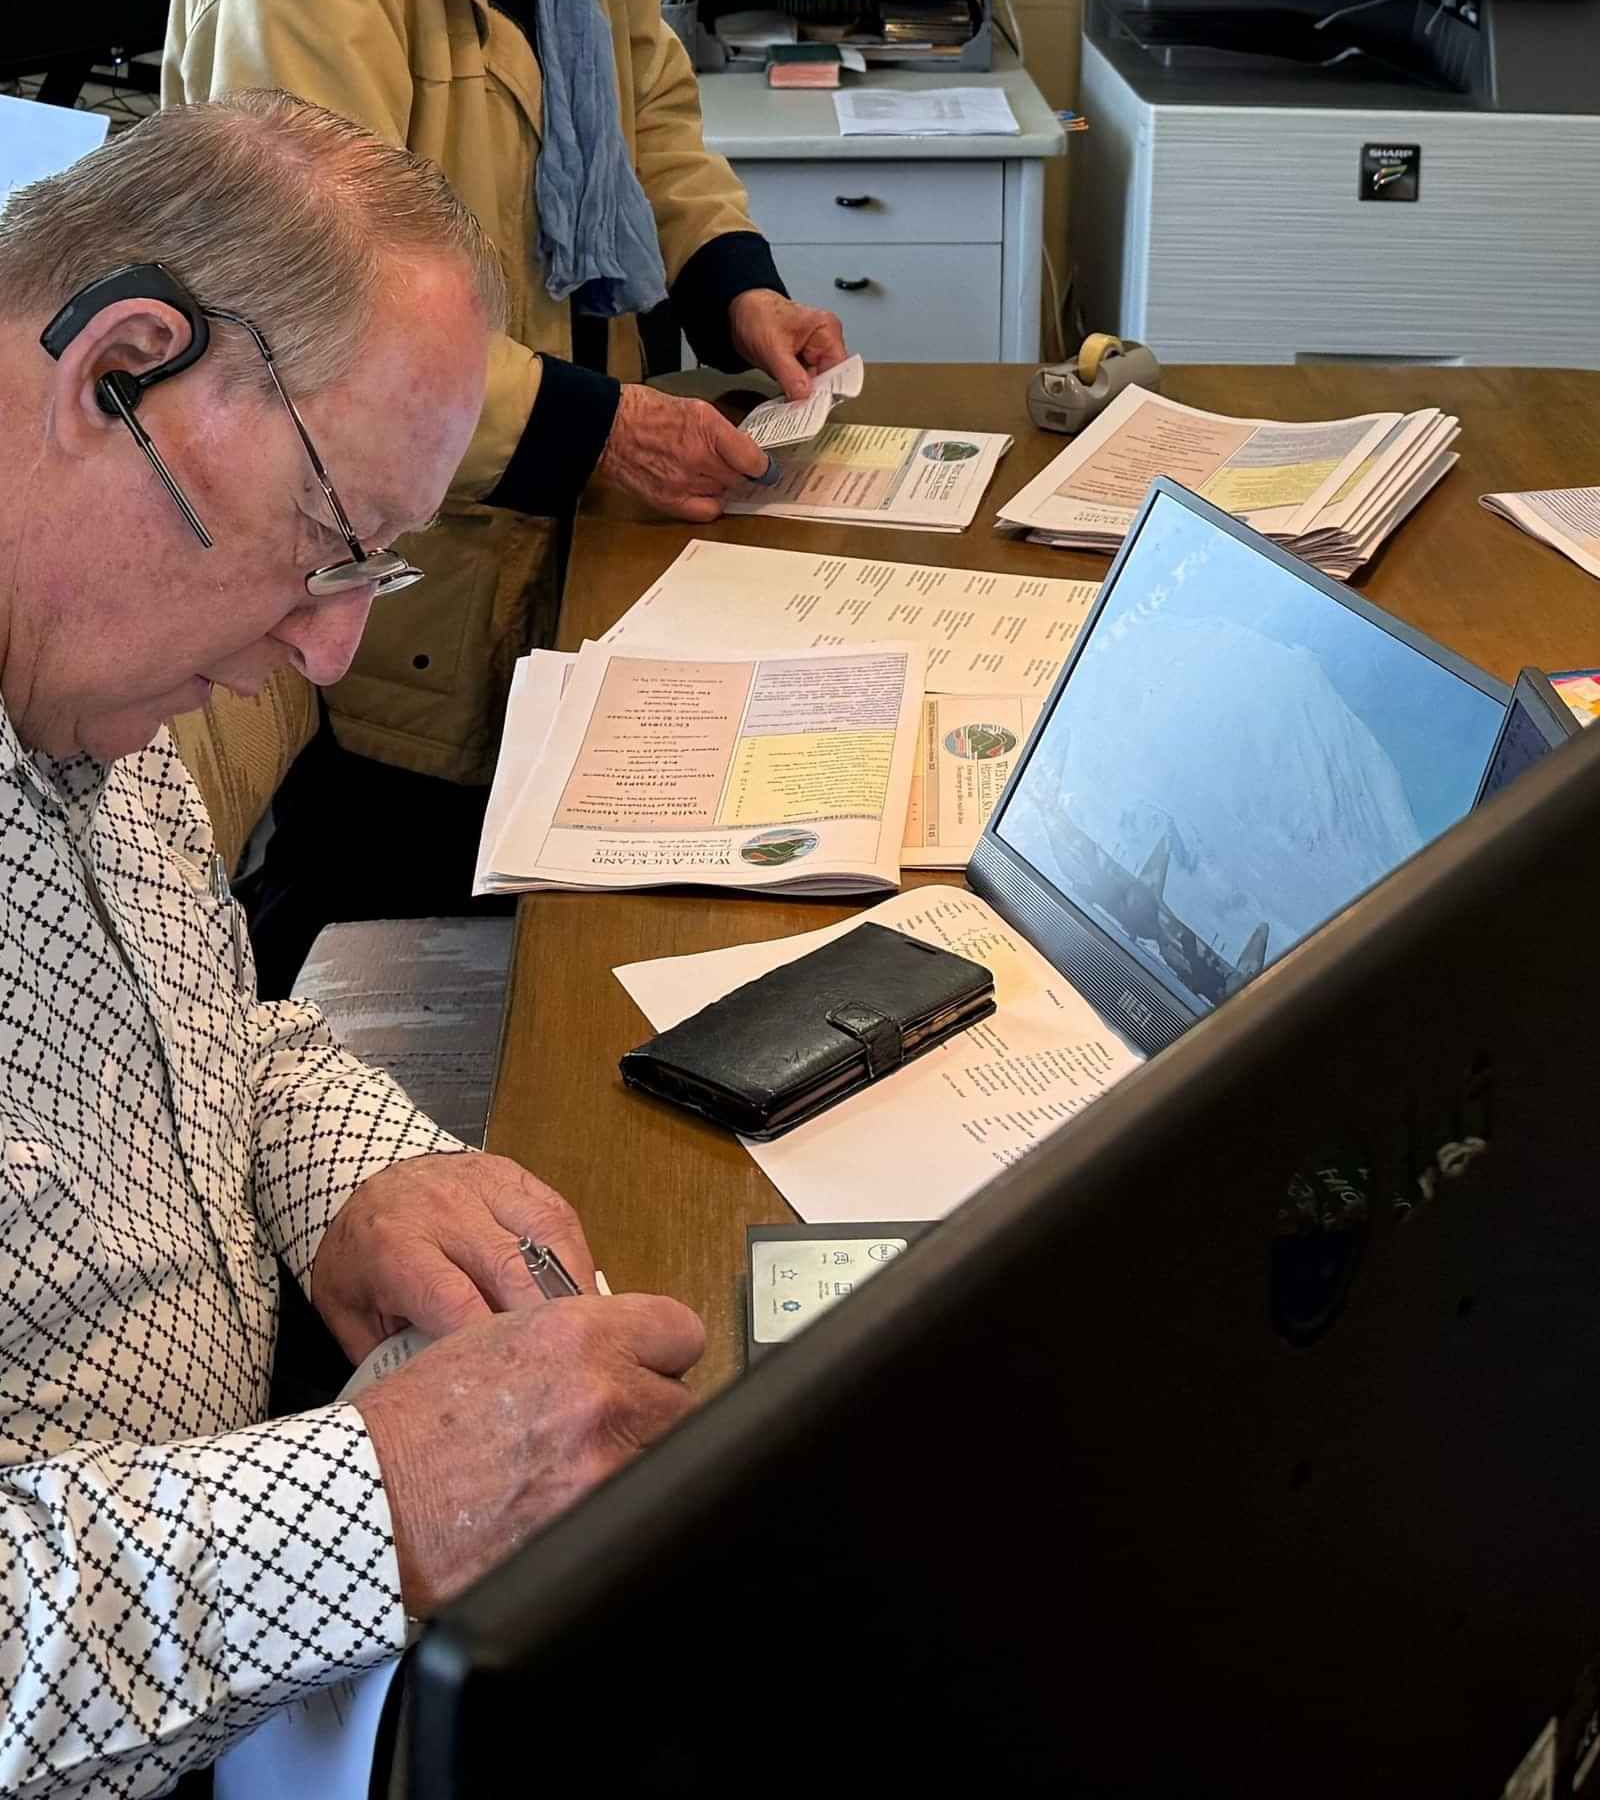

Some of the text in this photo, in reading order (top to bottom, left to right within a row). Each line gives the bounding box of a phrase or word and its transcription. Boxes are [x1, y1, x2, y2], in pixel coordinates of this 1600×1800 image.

[1369, 149, 1413, 158] SHARP
[591, 857, 731, 866] WEST AUCKLAND
